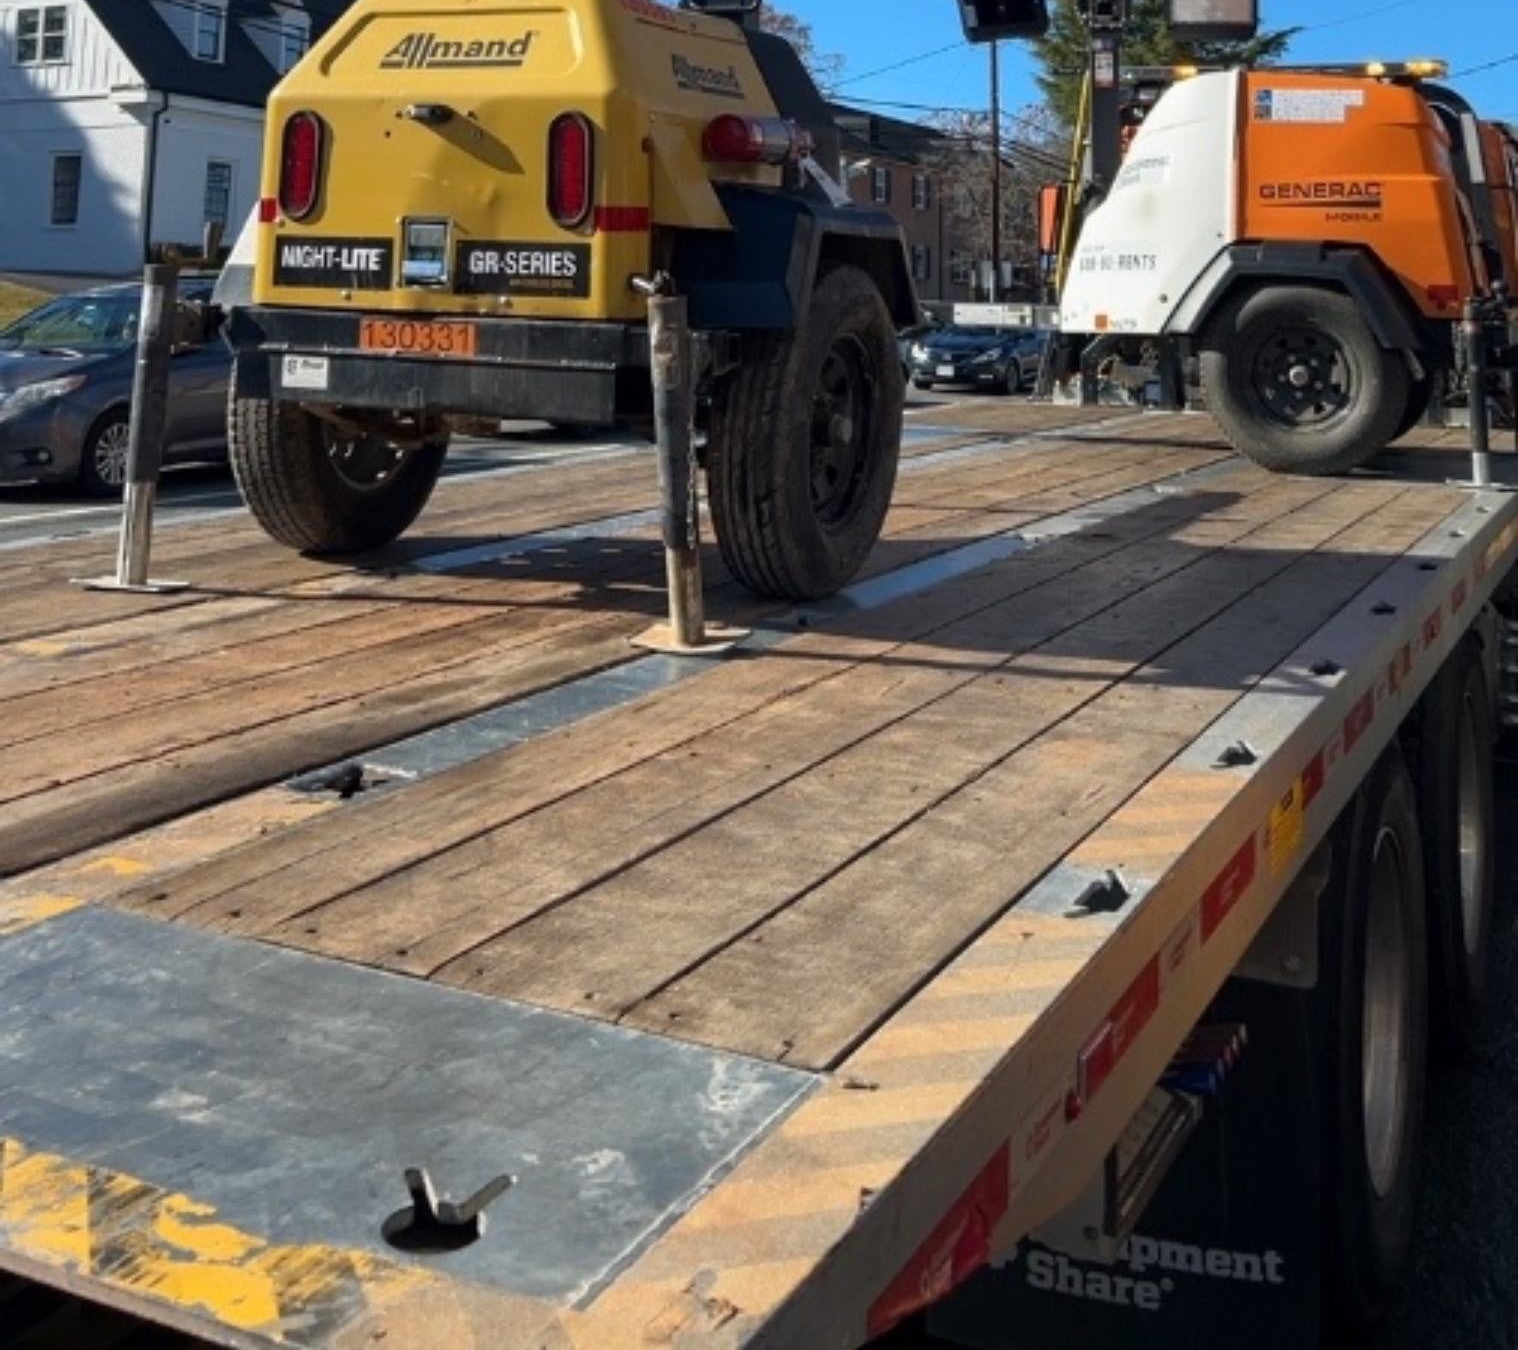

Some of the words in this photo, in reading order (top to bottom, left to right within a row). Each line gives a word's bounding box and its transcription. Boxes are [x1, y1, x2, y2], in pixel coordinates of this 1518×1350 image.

[379, 30, 533, 69] Allmand
[1259, 182, 1384, 199] GENERAC
[281, 245, 385, 272] NIGHT-LITE
[468, 250, 578, 277] GR-SERIES
[363, 321, 472, 353] 130331
